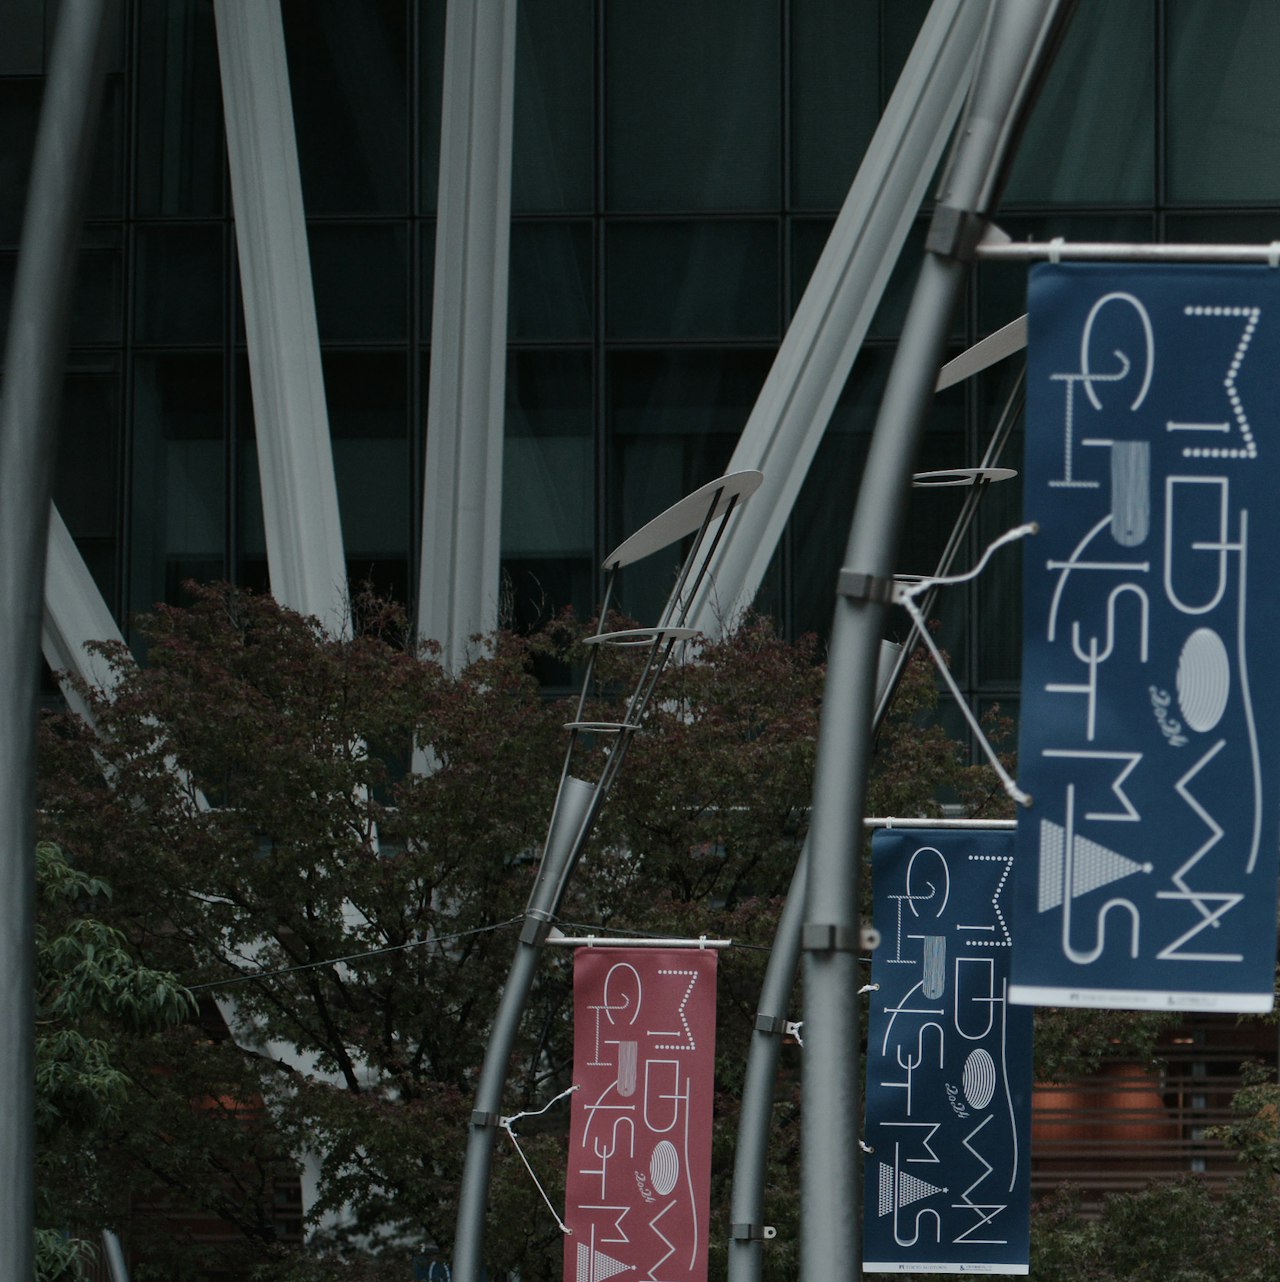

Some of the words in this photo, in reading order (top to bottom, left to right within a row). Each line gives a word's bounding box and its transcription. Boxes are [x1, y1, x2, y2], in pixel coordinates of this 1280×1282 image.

[1037, 291, 1155, 966] CHRISTMAS
[1147, 684, 1189, 748] 2024
[878, 846, 951, 1248] CHRISTMAS
[944, 1081, 971, 1120] 2024
[633, 1170, 654, 1205] 2024
